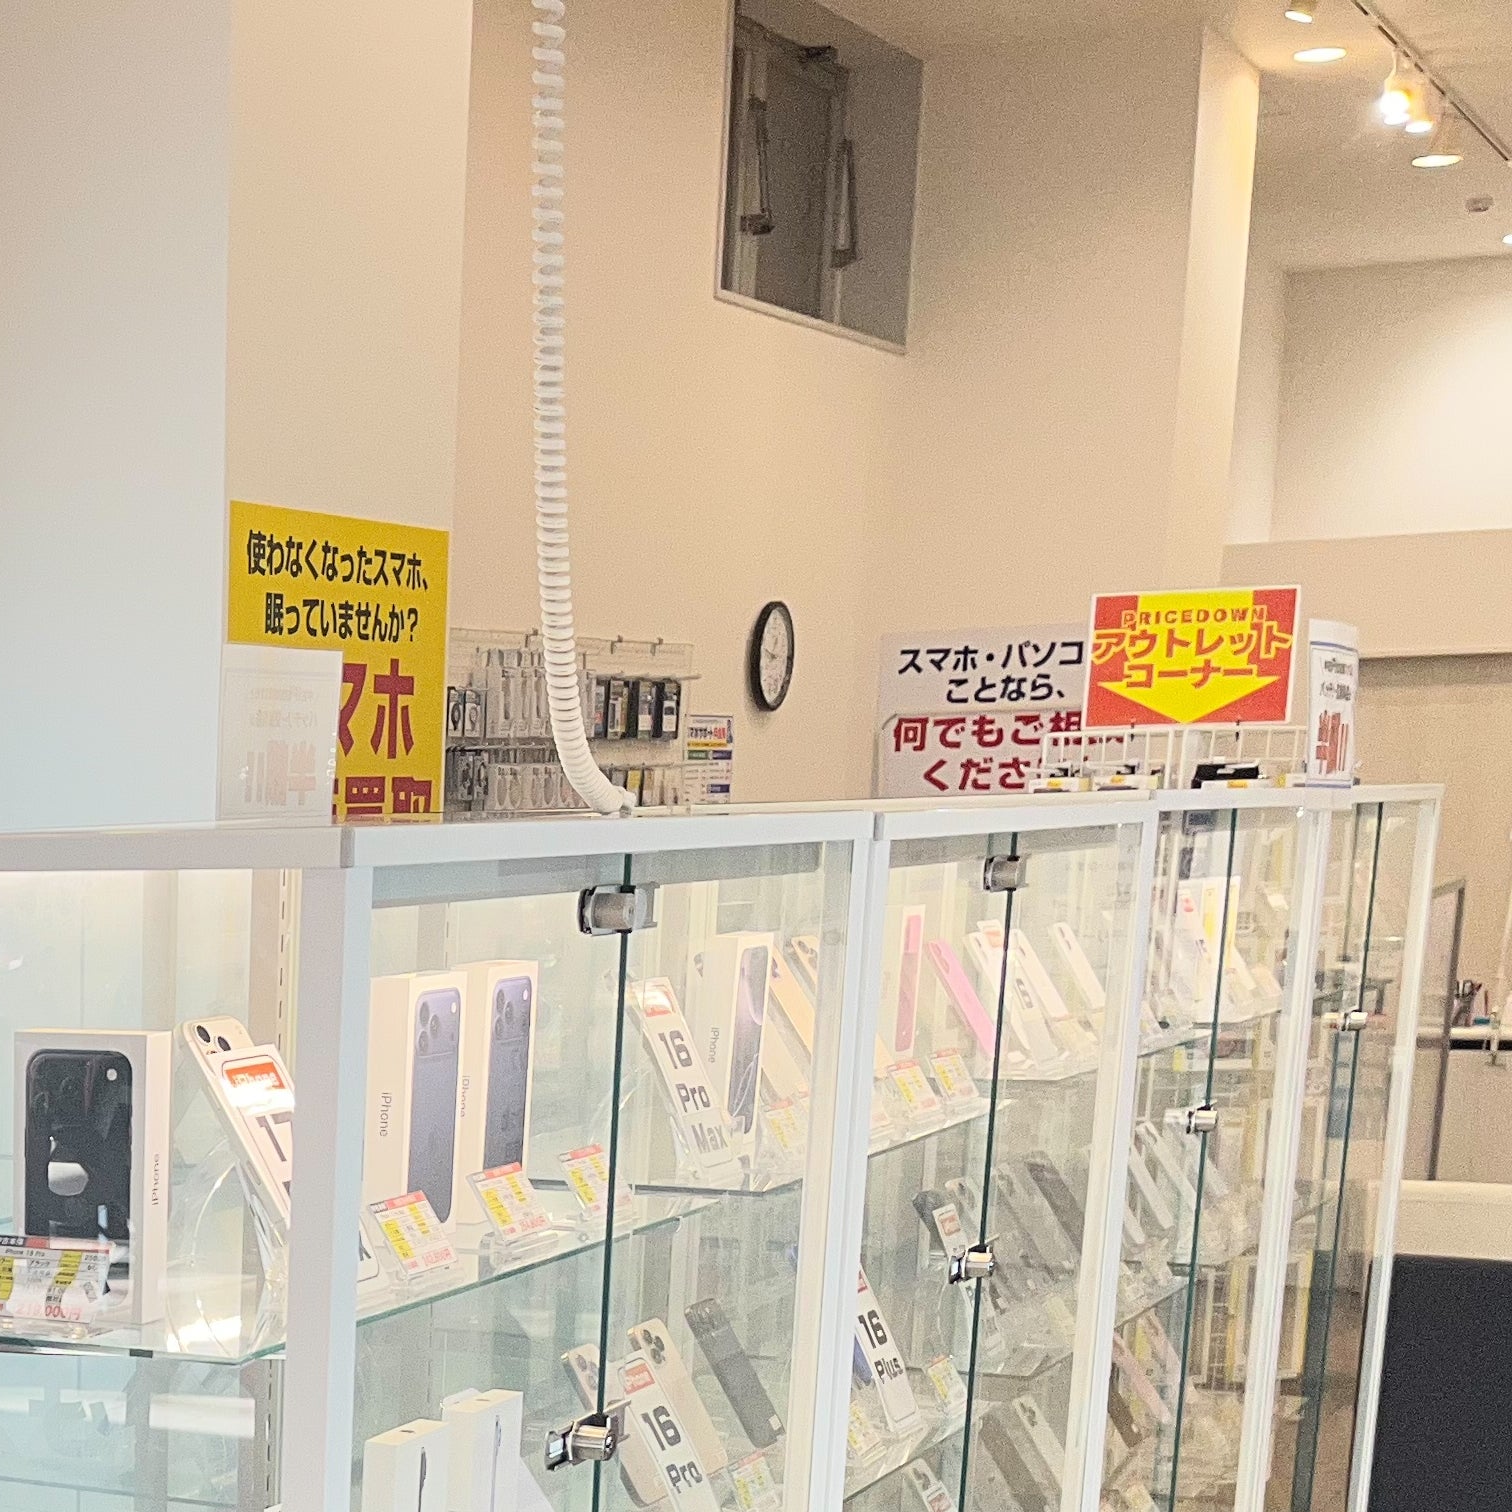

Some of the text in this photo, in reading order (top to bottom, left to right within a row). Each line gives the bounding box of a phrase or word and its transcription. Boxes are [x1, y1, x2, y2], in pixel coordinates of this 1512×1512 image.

[247, 529, 429, 591] 使わなくなったスマホ、
[1122, 607, 1266, 626] PRICEDOWN
[898, 640, 1085, 674] スマホ・パソコ
[1092, 622, 1293, 665] アウトレット
[946, 674, 1065, 703] ことなら、
[1125, 660, 1258, 689] コーナー
[339, 658, 414, 759] マホ
[893, 711, 1118, 752] 何でもご相
[923, 757, 1044, 791] くださ
[658, 1030, 693, 1070] 16
[708, 1027, 720, 1063] iPhone
[379, 1091, 392, 1138] iPhone
[675, 1083, 711, 1113] Pro
[691, 1123, 728, 1154] Max
[858, 1309, 888, 1349] 16
[874, 1357, 904, 1384] Plus
[640, 1405, 681, 1451] 16
[666, 1461, 703, 1494] Pro
